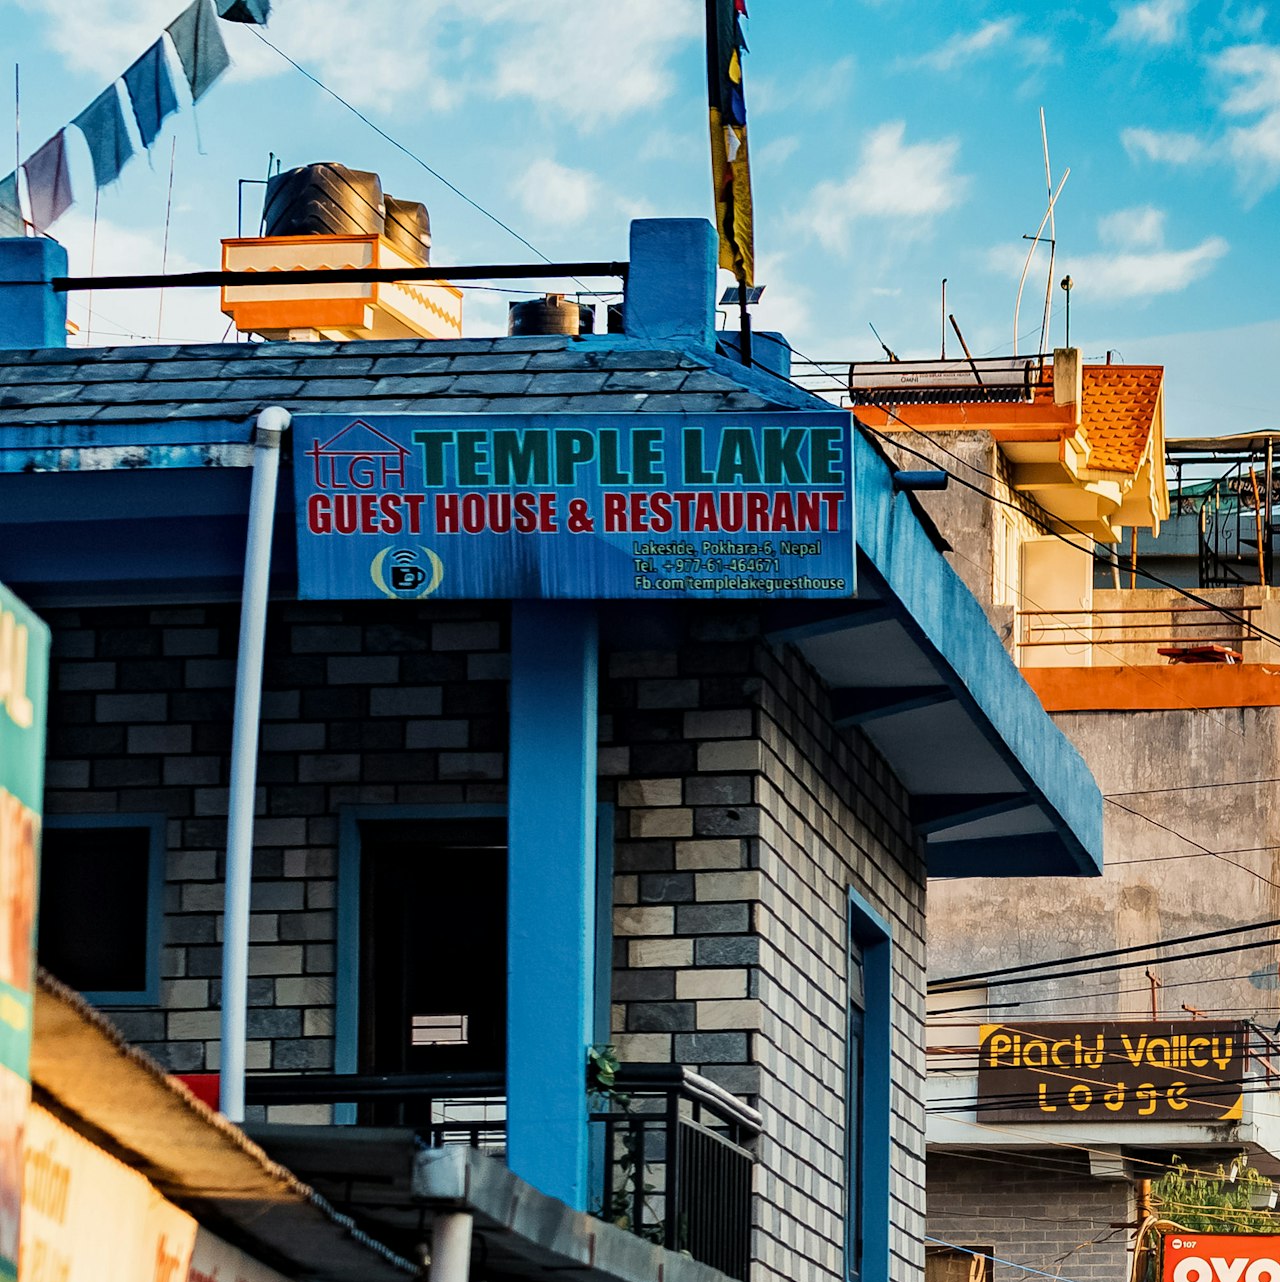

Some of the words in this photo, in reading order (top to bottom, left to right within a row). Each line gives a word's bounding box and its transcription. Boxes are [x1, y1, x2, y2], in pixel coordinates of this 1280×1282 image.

[411, 427, 666, 488] TEMPLE
[681, 426, 845, 486] LAKE
[307, 493, 426, 535] GUEST
[435, 492, 559, 535] HOUSE
[567, 497, 595, 534] &
[603, 490, 845, 533] RESTAURANT
[634, 542, 698, 557] Lakeside,
[781, 542, 821, 558] Nepal
[634, 559, 657, 573] Tel.
[989, 1034, 1105, 1070] Placid
[1120, 1033, 1237, 1071] Valley
[1038, 1082, 1190, 1116] Lodge
[1182, 1241, 1197, 1249] 107
